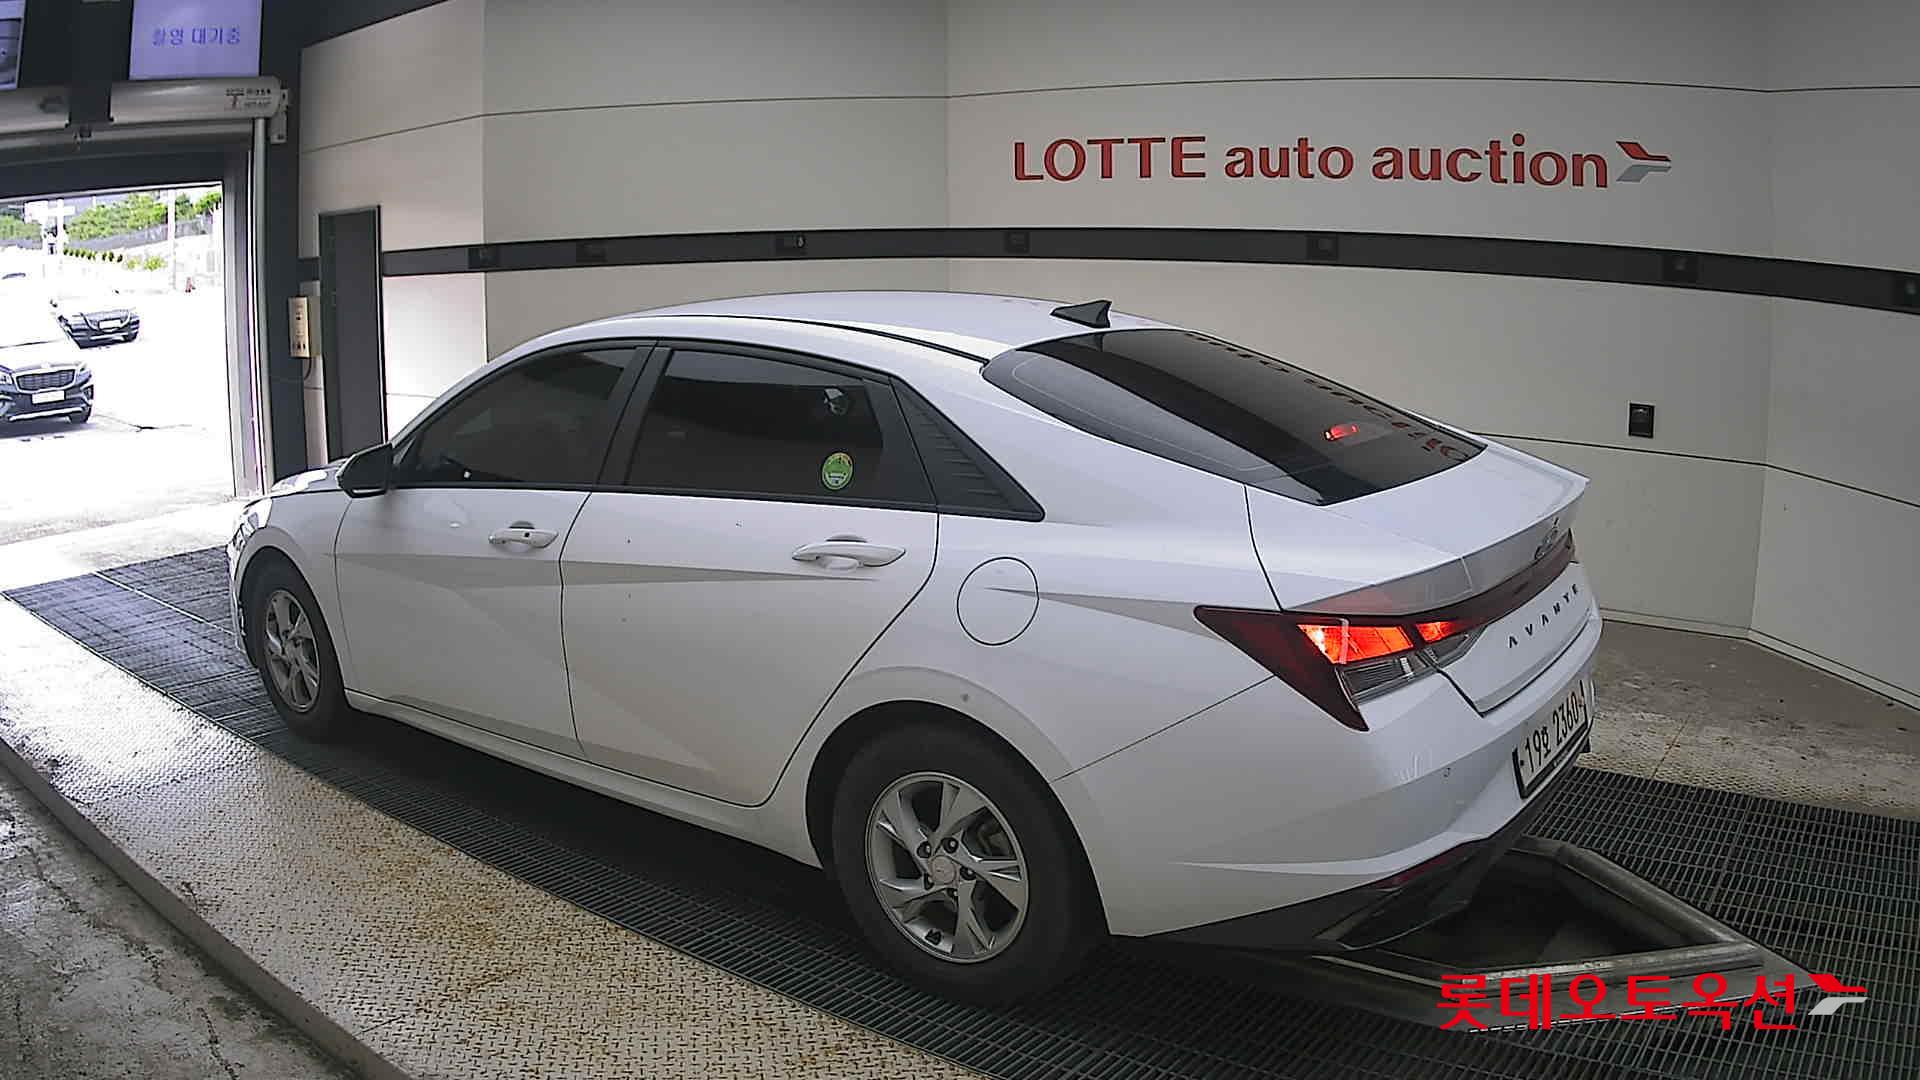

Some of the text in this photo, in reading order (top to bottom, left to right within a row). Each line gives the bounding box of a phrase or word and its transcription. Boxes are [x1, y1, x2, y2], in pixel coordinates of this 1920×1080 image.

[1014, 133, 1608, 188] LOTTE auto auction
[1508, 584, 1579, 648] AVANTE
[1553, 691, 1579, 746] 2360
